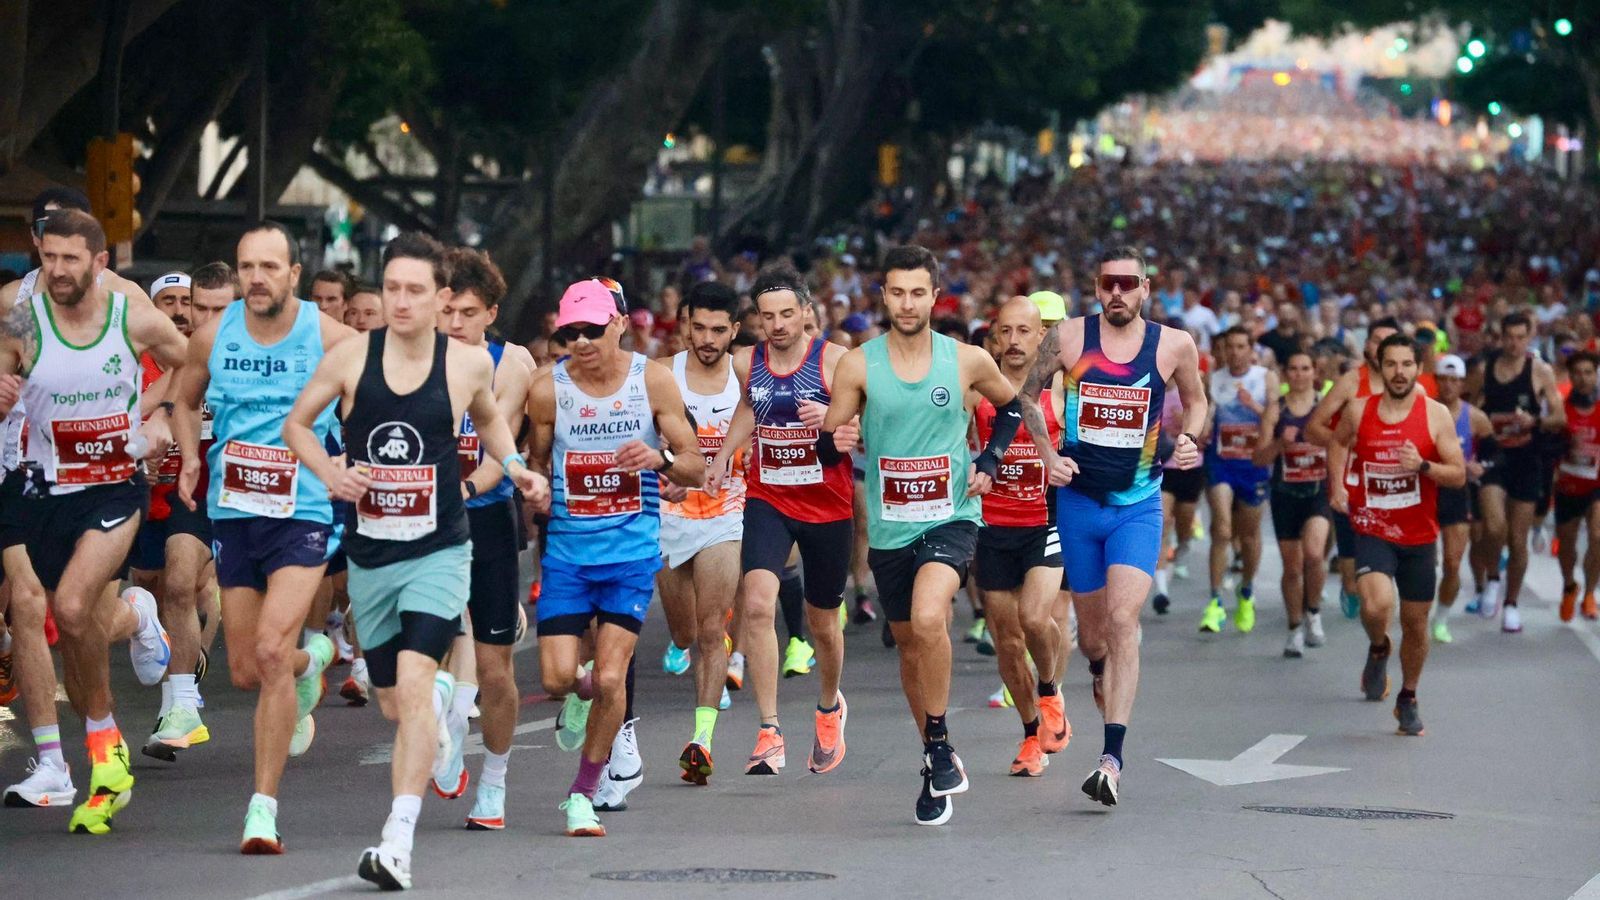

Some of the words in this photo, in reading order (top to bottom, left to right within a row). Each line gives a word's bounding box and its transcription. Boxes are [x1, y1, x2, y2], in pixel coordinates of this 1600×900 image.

[223, 355, 288, 377] nerja
[51, 391, 100, 406] Togher
[104, 386, 122, 399] AC
[1099, 388, 1145, 400] GENERALI
[1093, 406, 1134, 421] 13598
[73, 415, 126, 432] GENERALI
[569, 419, 641, 436] MARACENA
[770, 430, 813, 439] GENERALI
[75, 440, 113, 455] 6024
[769, 447, 806, 460] 13399
[896, 458, 945, 471] GENERALI
[1001, 464, 1024, 475] 255
[236, 467, 280, 486] 13862
[372, 469, 429, 481] GENERALI
[583, 474, 621, 488] 6168
[894, 480, 937, 494] 17672
[369, 491, 417, 508] 15057
